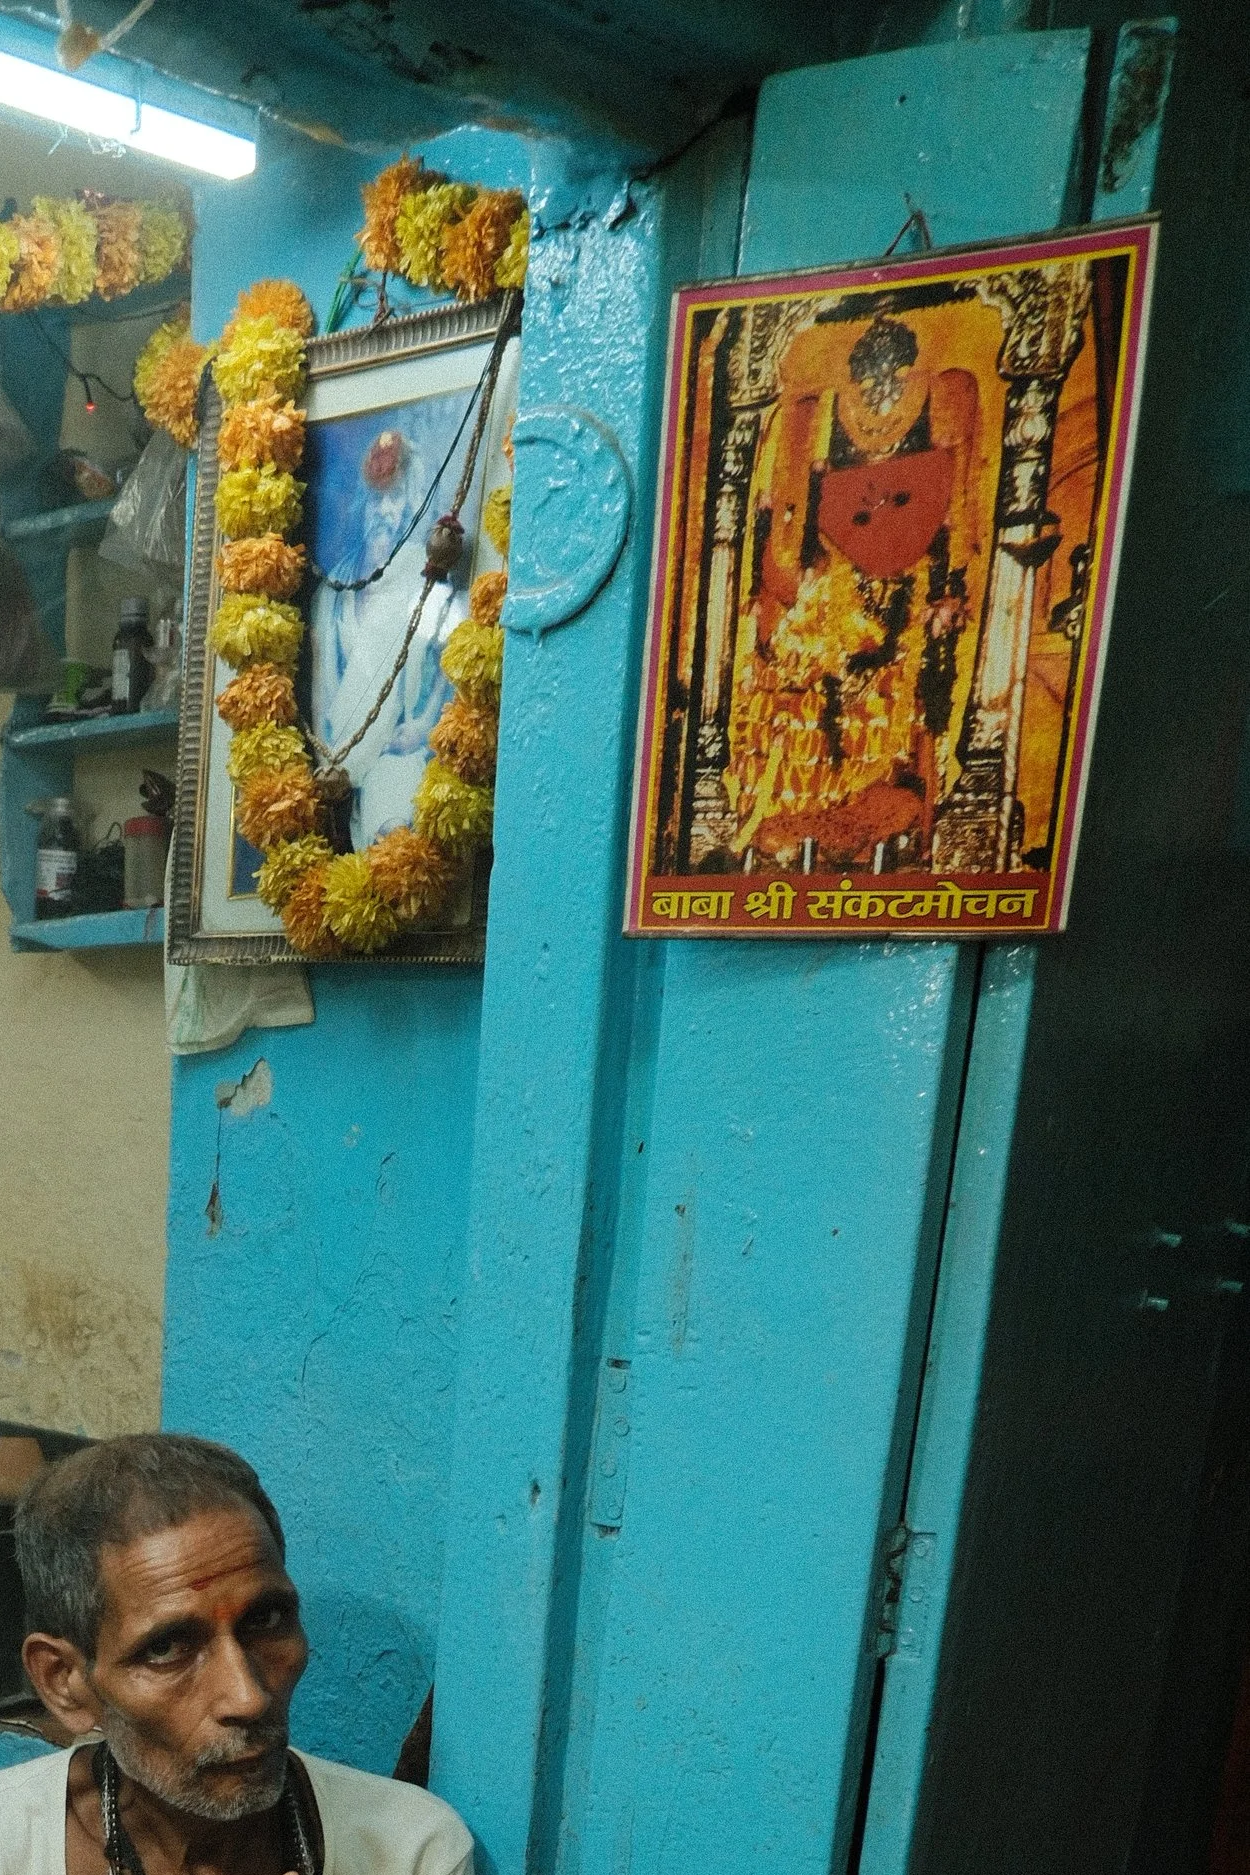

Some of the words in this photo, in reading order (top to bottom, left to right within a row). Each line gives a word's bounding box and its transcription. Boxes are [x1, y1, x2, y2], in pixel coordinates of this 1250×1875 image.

[651, 889, 735, 921] बाबा
[743, 880, 796, 921] श्री
[805, 879, 1040, 921] संकटमोचन
